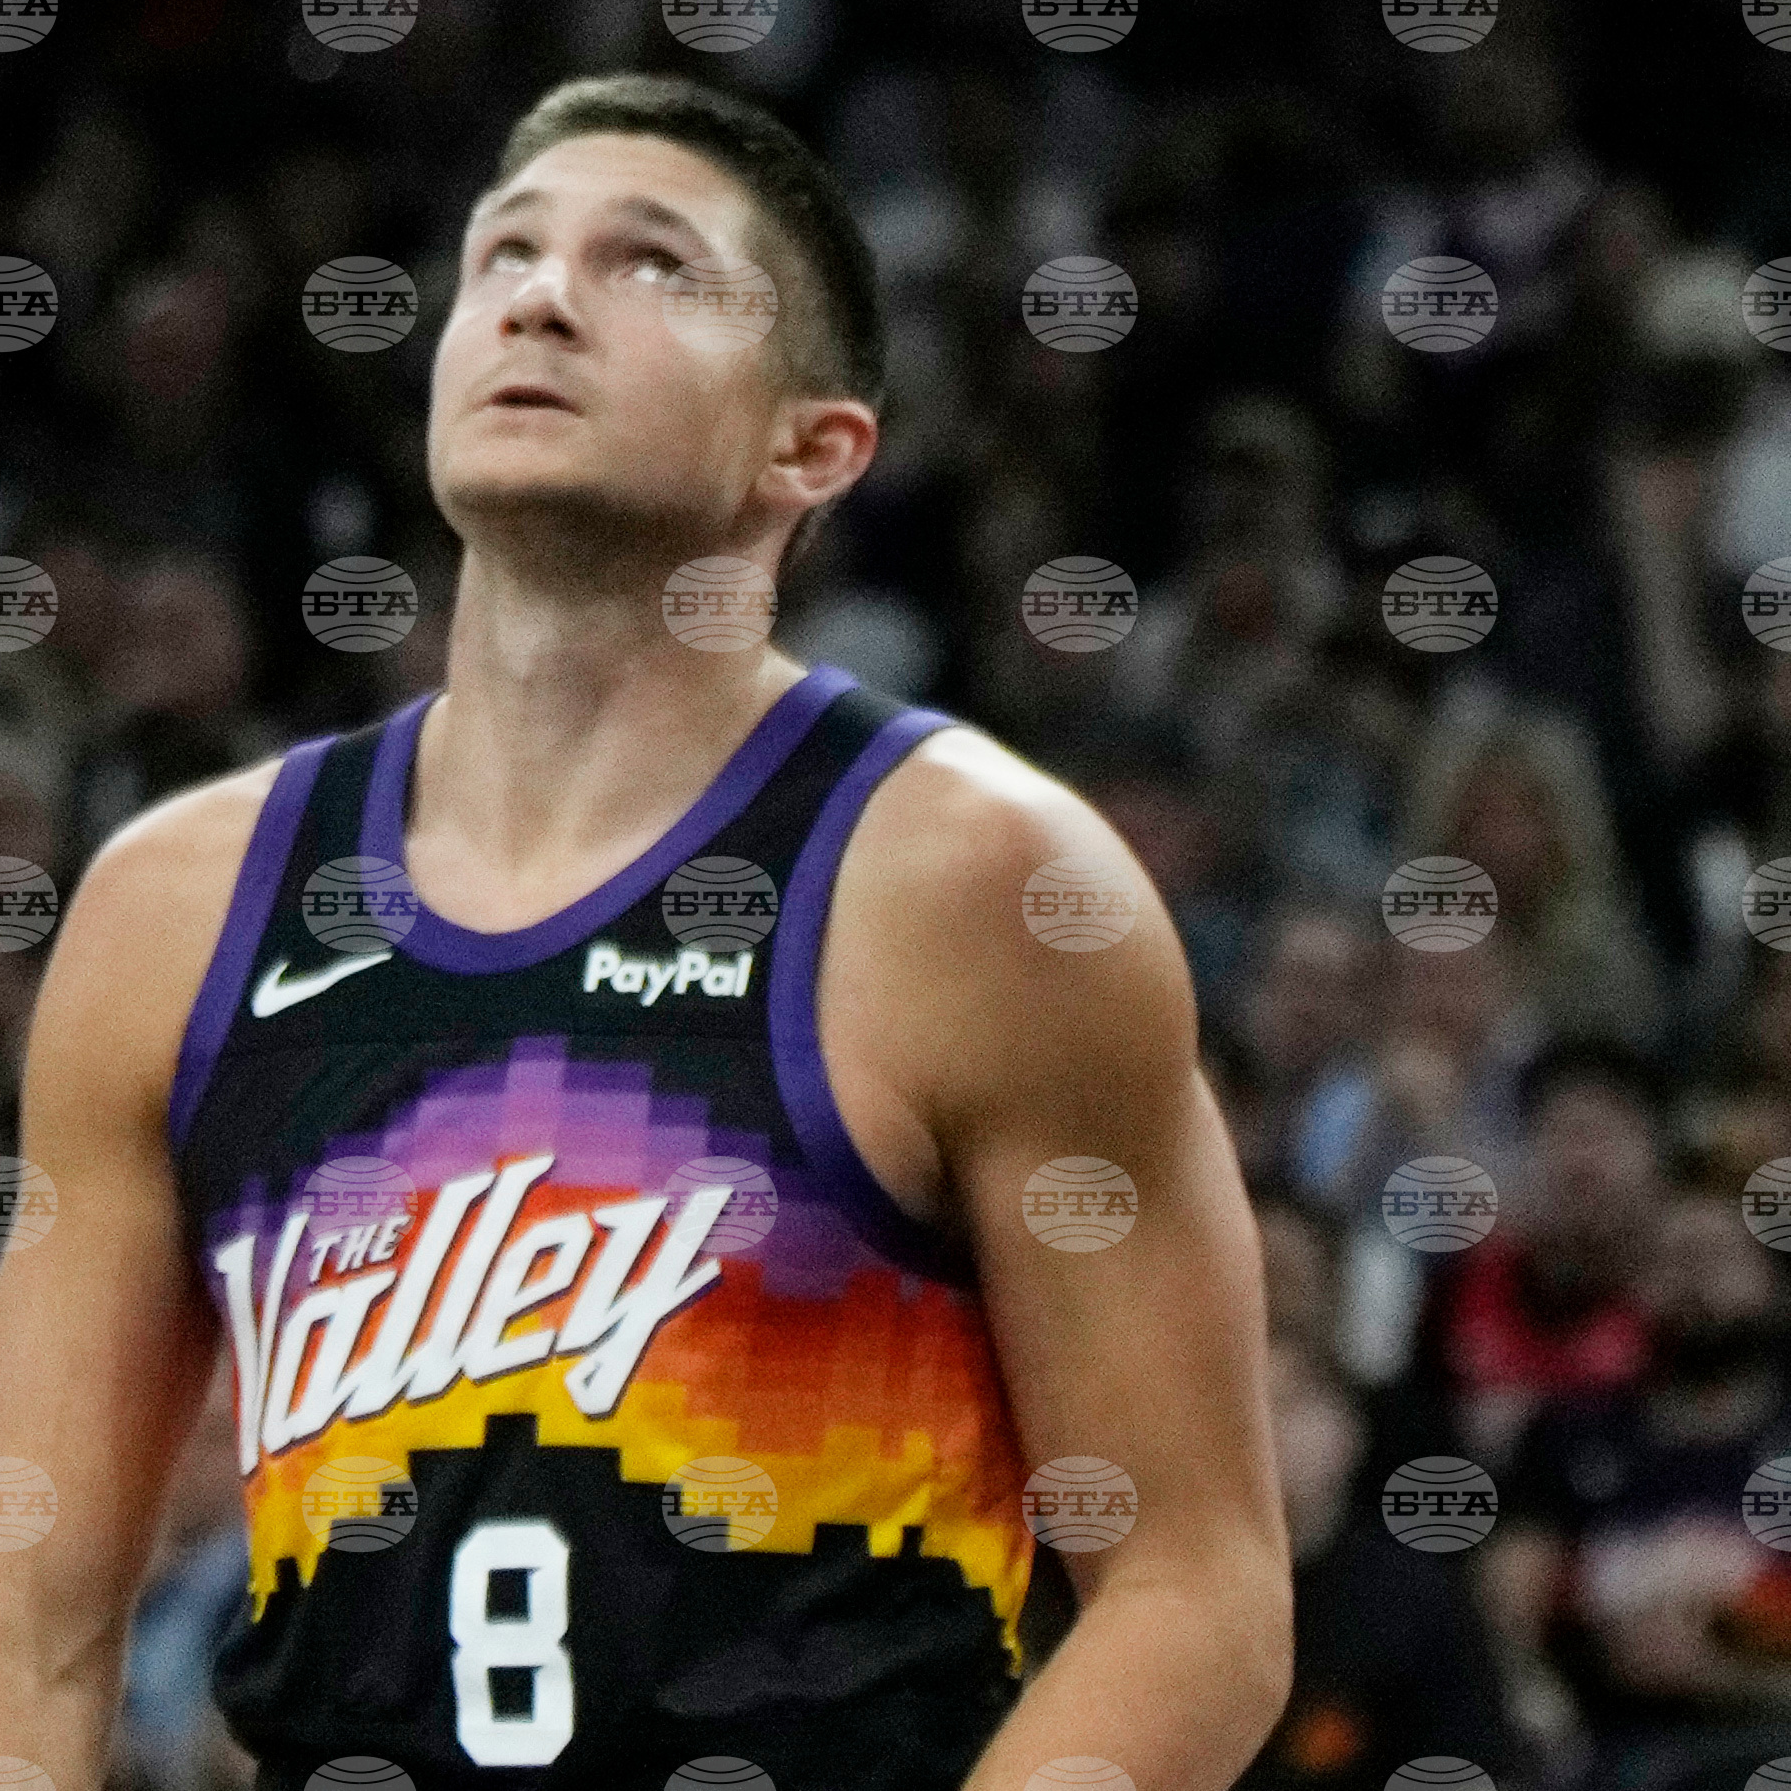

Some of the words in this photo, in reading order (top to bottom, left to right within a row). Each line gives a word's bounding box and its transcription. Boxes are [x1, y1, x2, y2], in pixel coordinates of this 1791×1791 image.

[583, 947, 753, 1007] PayPal
[215, 1154, 734, 1475] Valley
[310, 1216, 408, 1282] THE
[449, 1522, 575, 1767] 8
